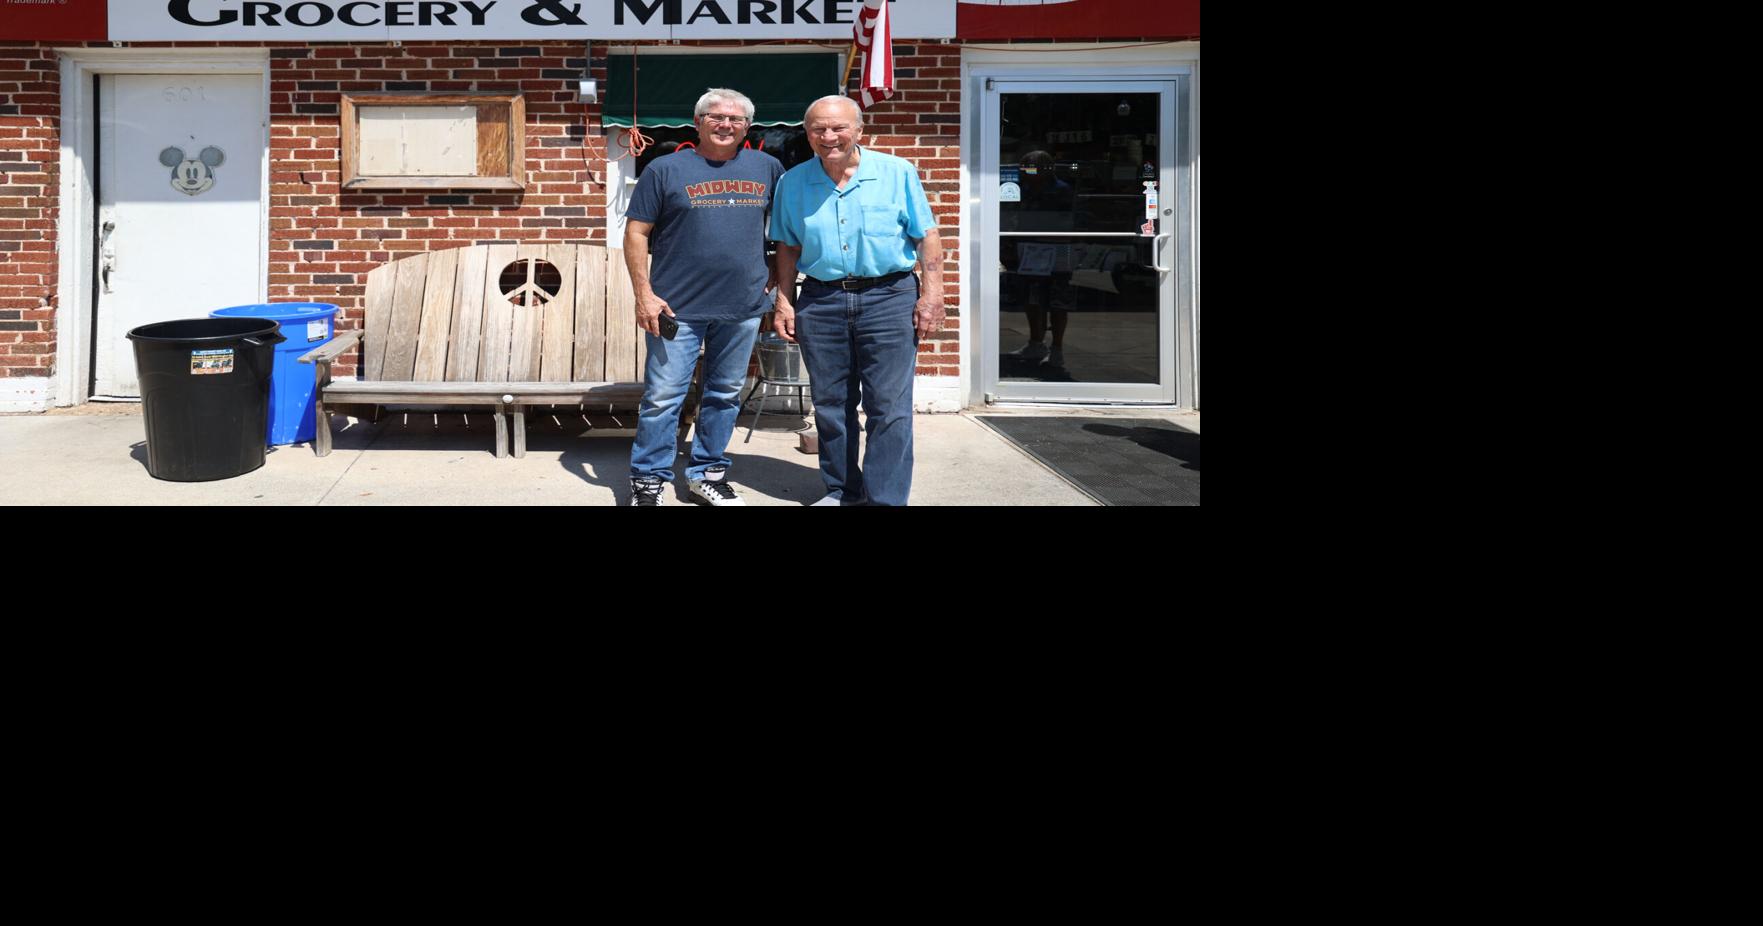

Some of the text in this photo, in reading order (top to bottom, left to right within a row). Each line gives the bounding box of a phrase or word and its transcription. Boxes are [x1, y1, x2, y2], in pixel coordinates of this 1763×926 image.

[167, 0, 898, 26] GROCERY & MARKE
[685, 180, 766, 198] MIDWAY
